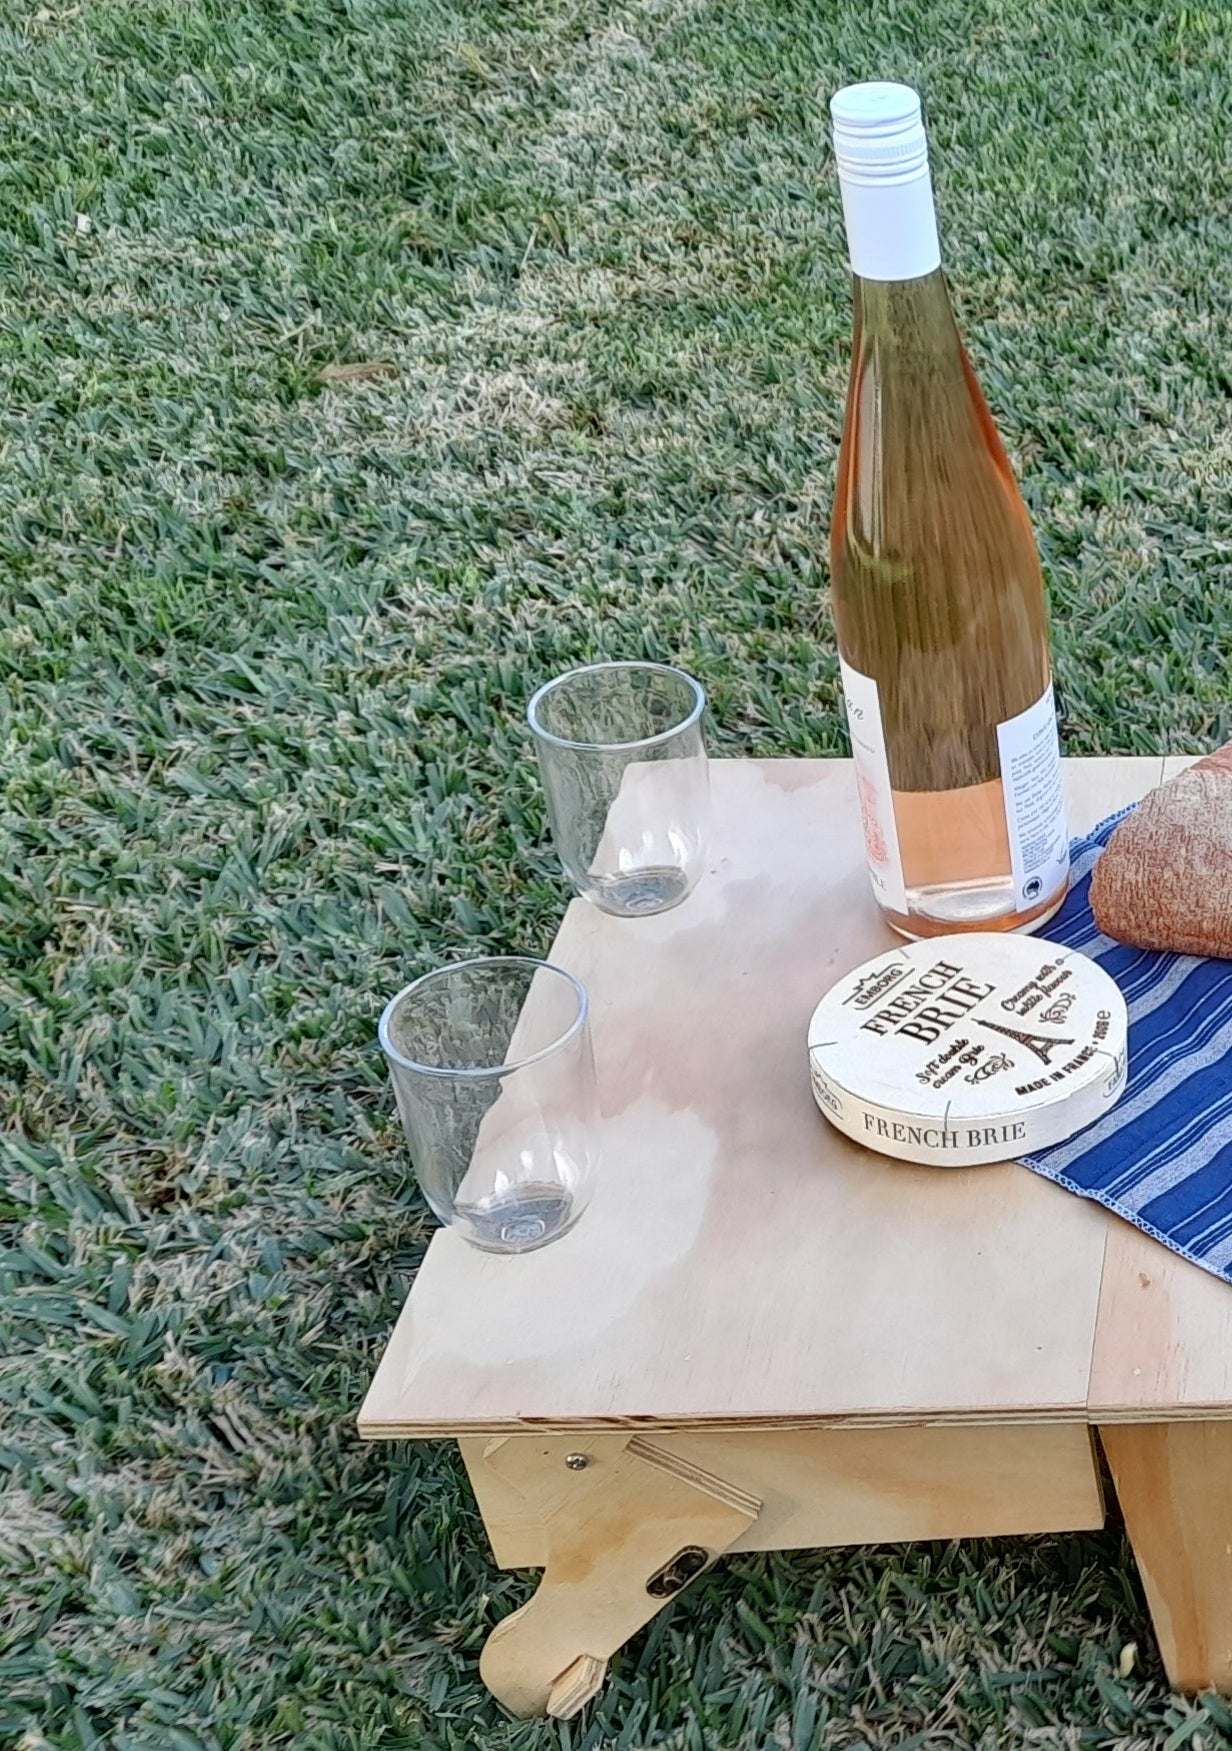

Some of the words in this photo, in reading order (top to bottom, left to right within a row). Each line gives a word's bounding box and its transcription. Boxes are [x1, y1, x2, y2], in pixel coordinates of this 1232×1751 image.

[855, 968, 903, 1005] EMBORG
[860, 960, 963, 1037] FRENCH
[1000, 980, 1038, 1012] Creamy
[1035, 964, 1057, 982] with
[894, 976, 997, 1046] BRIE
[915, 1059, 940, 1085] Soft
[938, 1039, 970, 1065] double
[933, 1064, 962, 1090] cream
[1014, 1078, 1052, 1096] MADE
[1049, 1070, 1066, 1082] IN
[1061, 1045, 1098, 1075] FRANCE
[862, 1112, 960, 1149] FRENCH
[966, 1121, 1027, 1149] BRIE
